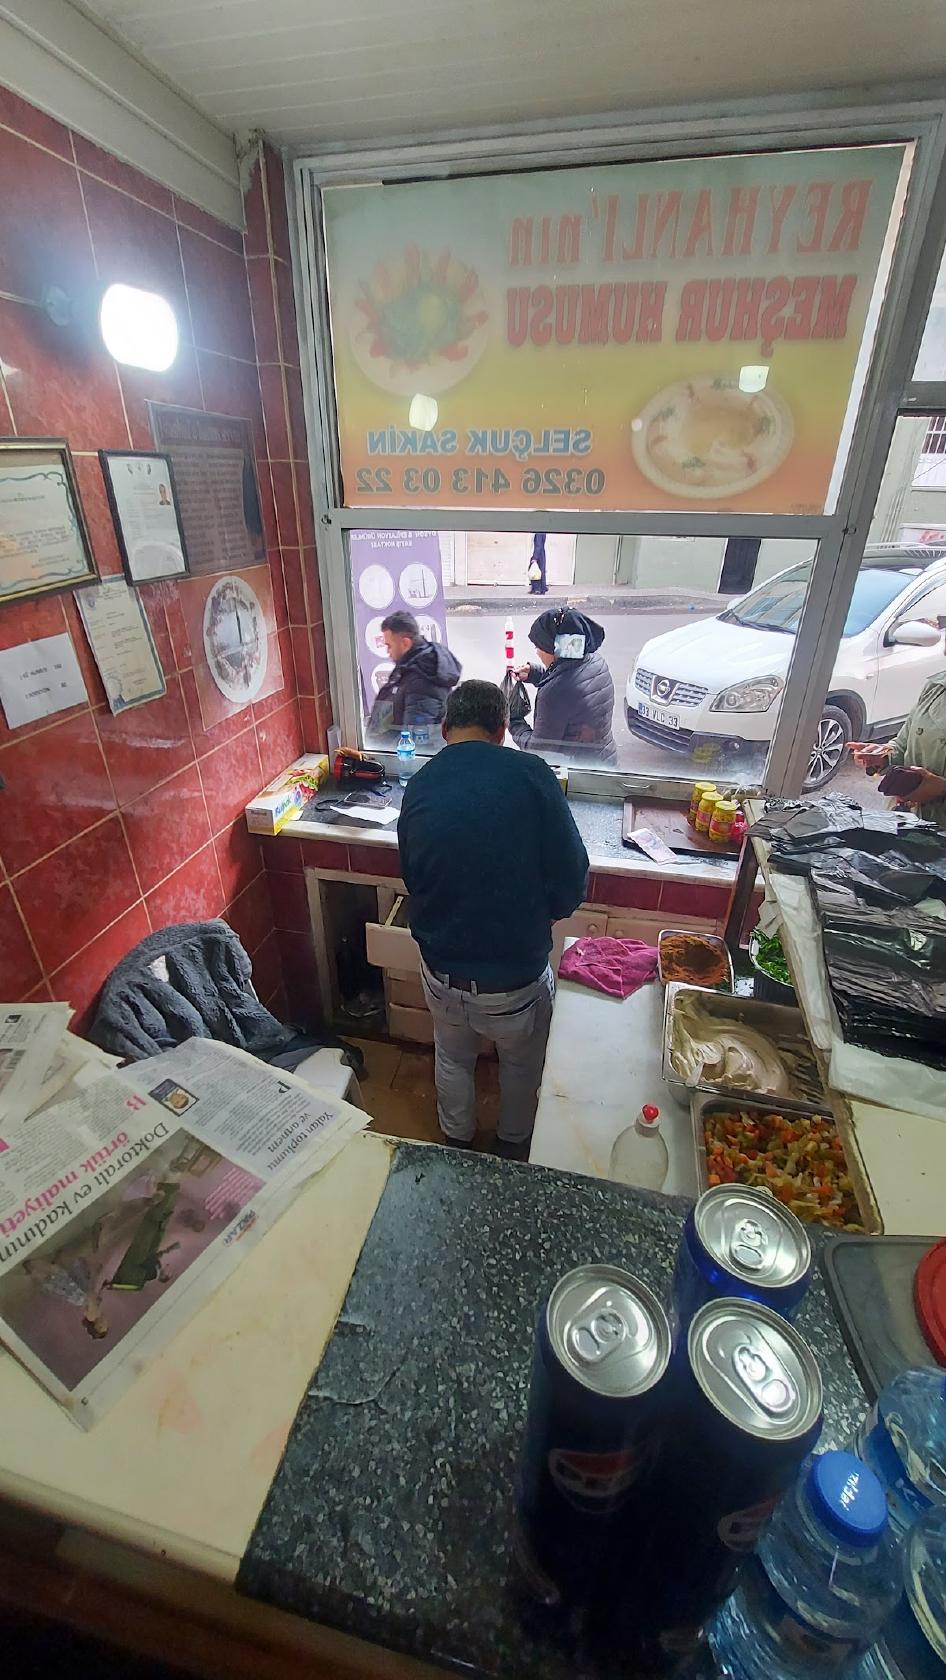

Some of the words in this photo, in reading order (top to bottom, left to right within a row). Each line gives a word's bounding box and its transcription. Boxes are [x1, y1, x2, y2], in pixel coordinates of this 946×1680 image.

[668, 716, 678, 727] 33
[300, 1112, 312, 1124] ve
[306, 1111, 334, 1135] Yalan
[80, 1131, 130, 1173] örtük
[267, 1121, 300, 1153] annem
[93, 1122, 170, 1186] Doktoralı
[0, 1170, 79, 1238] maliyeti
[73, 1184, 93, 1204] ev
[0, 1201, 73, 1262] kadının
